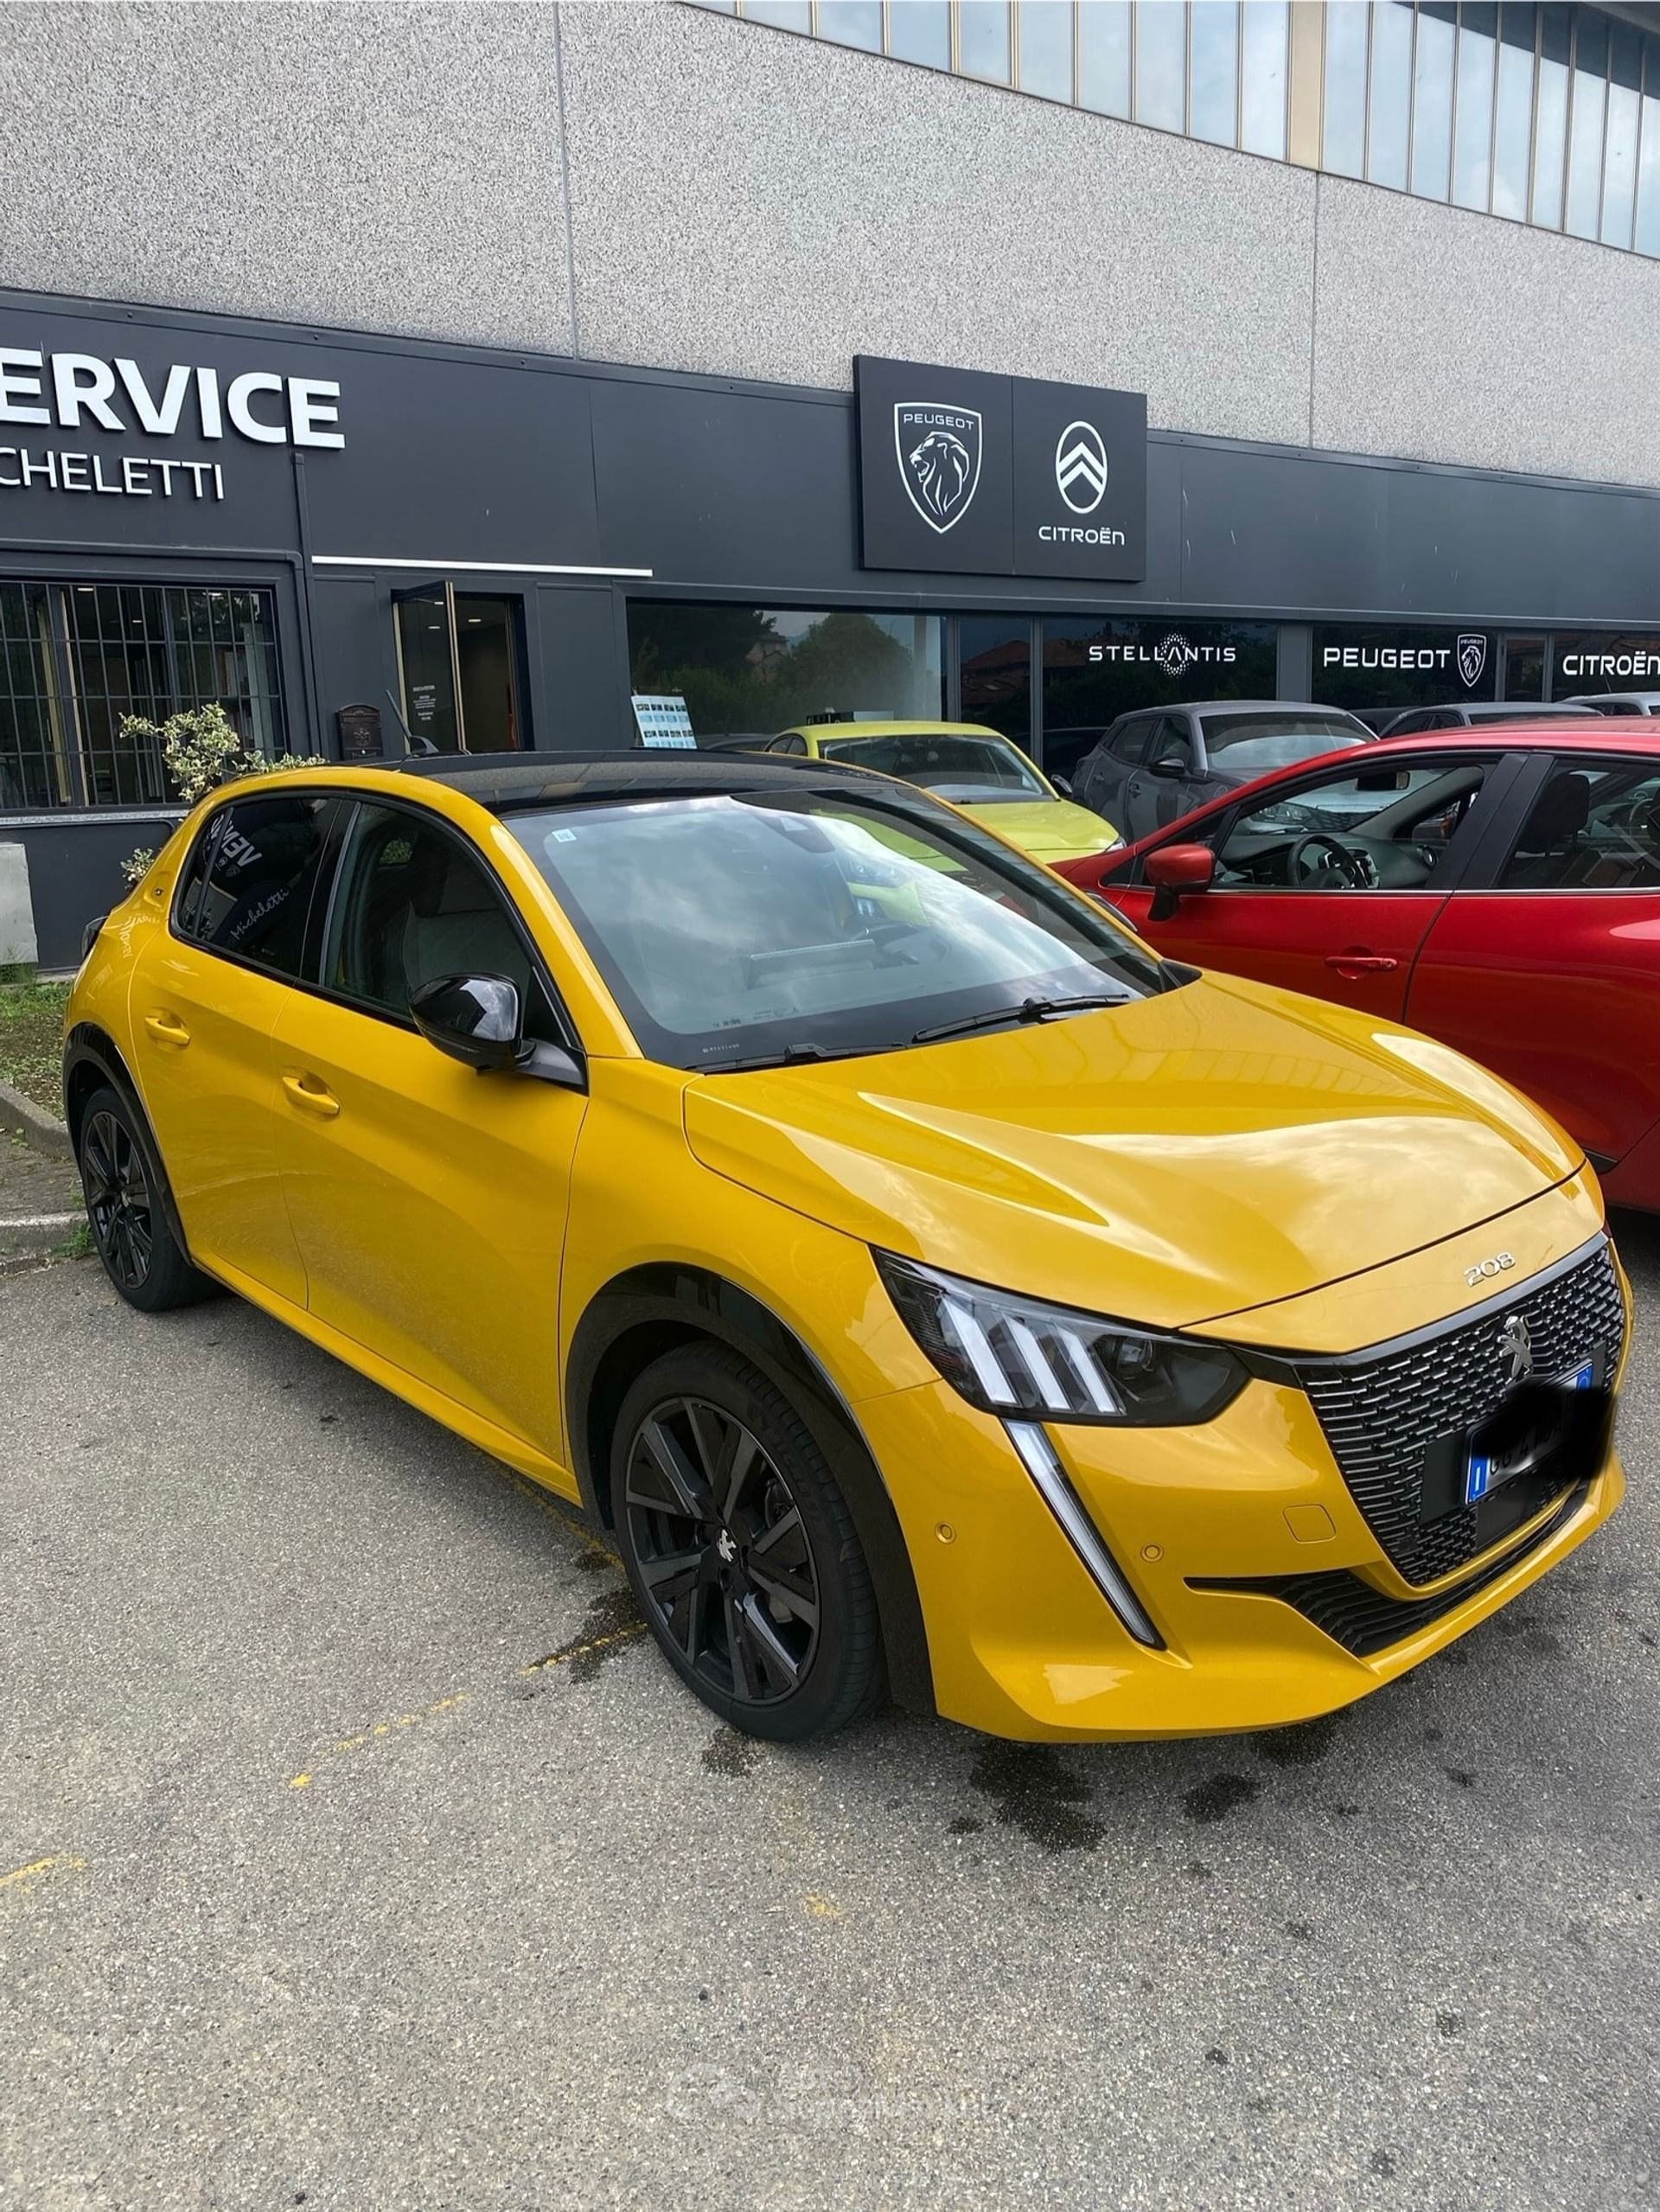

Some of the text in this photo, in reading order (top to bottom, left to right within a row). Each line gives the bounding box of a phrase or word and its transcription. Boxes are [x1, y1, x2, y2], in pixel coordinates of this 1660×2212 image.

[903, 412, 974, 431] PEUGEOT
[1089, 645, 1236, 663] STELLANTIS
[1324, 647, 1451, 669] PEUGEOT
[1463, 1251, 1516, 1287] 208
